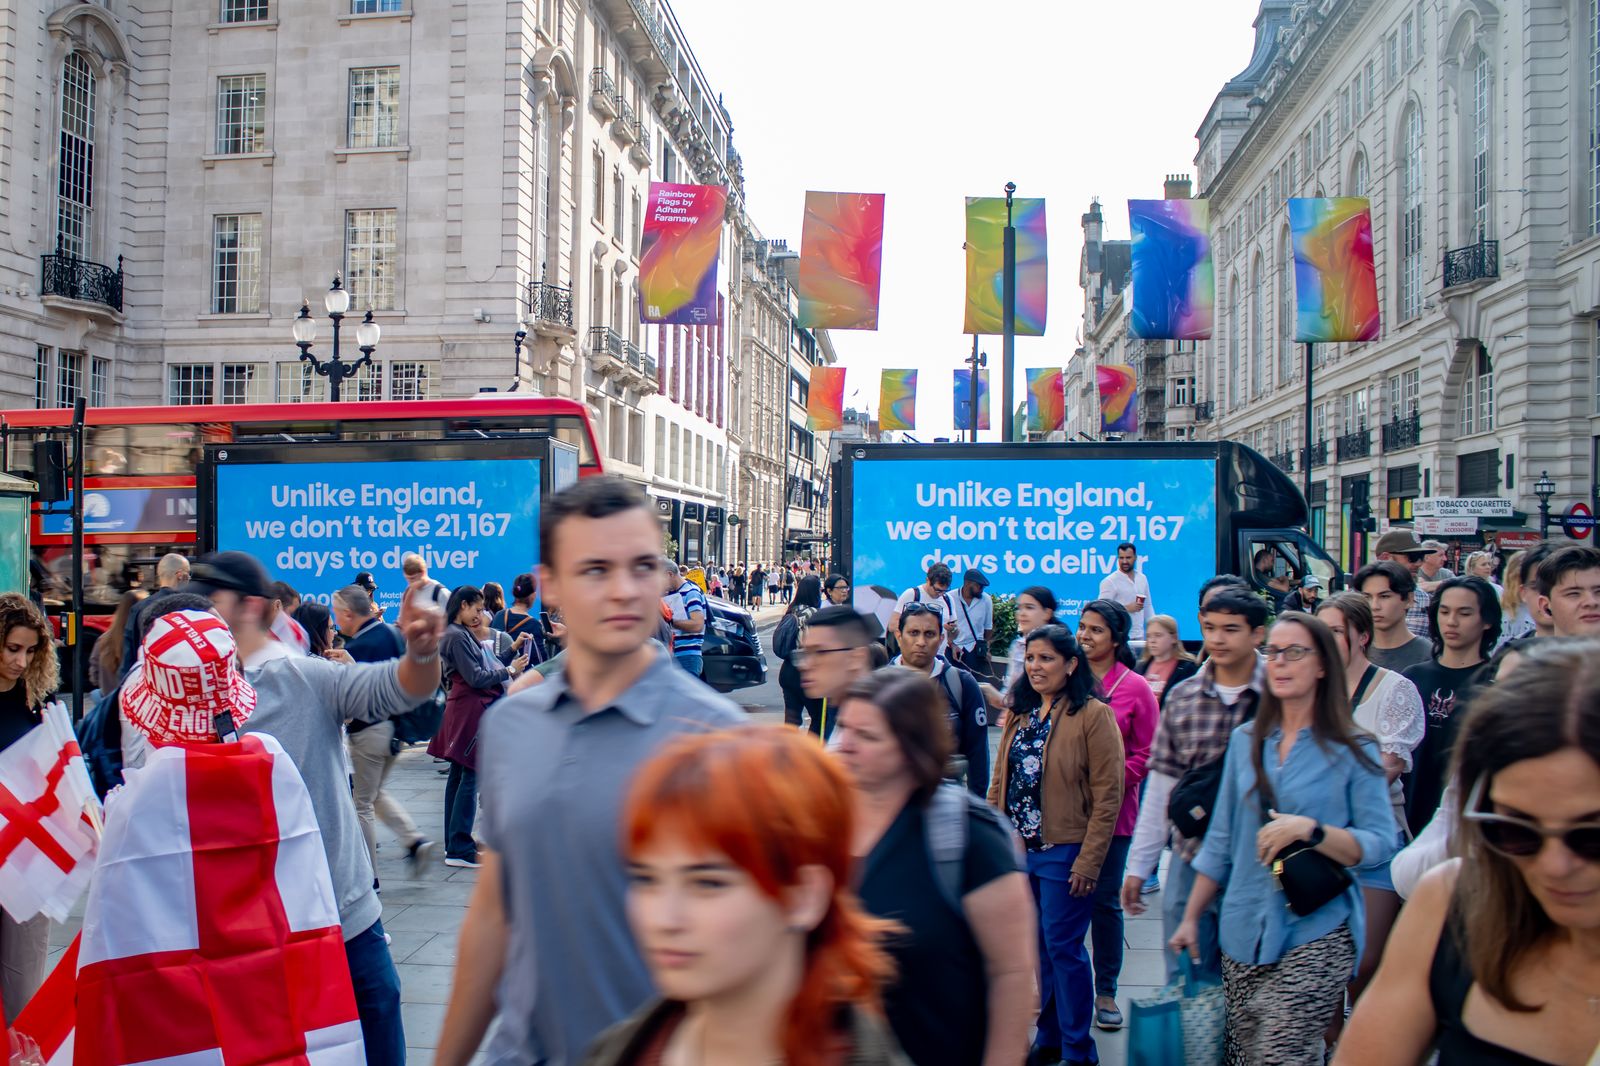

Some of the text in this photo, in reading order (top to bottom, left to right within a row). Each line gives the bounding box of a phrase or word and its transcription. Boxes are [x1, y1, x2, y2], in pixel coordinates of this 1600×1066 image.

[657, 198, 693, 207] Flags by
[658, 190, 696, 198] Rainbow
[654, 214, 699, 224] Faramawy
[655, 206, 687, 214] Adham
[271, 481, 483, 513] Unlike England,
[916, 480, 1153, 516] Unlike England,
[1471, 500, 1512, 508] CIGARETTES
[245, 520, 285, 539] we
[366, 513, 430, 538] take
[435, 512, 512, 541] 21,167
[884, 521, 933, 541] we
[1023, 515, 1095, 541] take
[1100, 515, 1185, 544] 21,167
[276, 547, 345, 577] days
[349, 547, 377, 569] to
[1003, 550, 1036, 574] to
[1040, 547, 1148, 575] delivr
[171, 616, 208, 649] ENGLAND
[975, 706, 988, 727] 6
